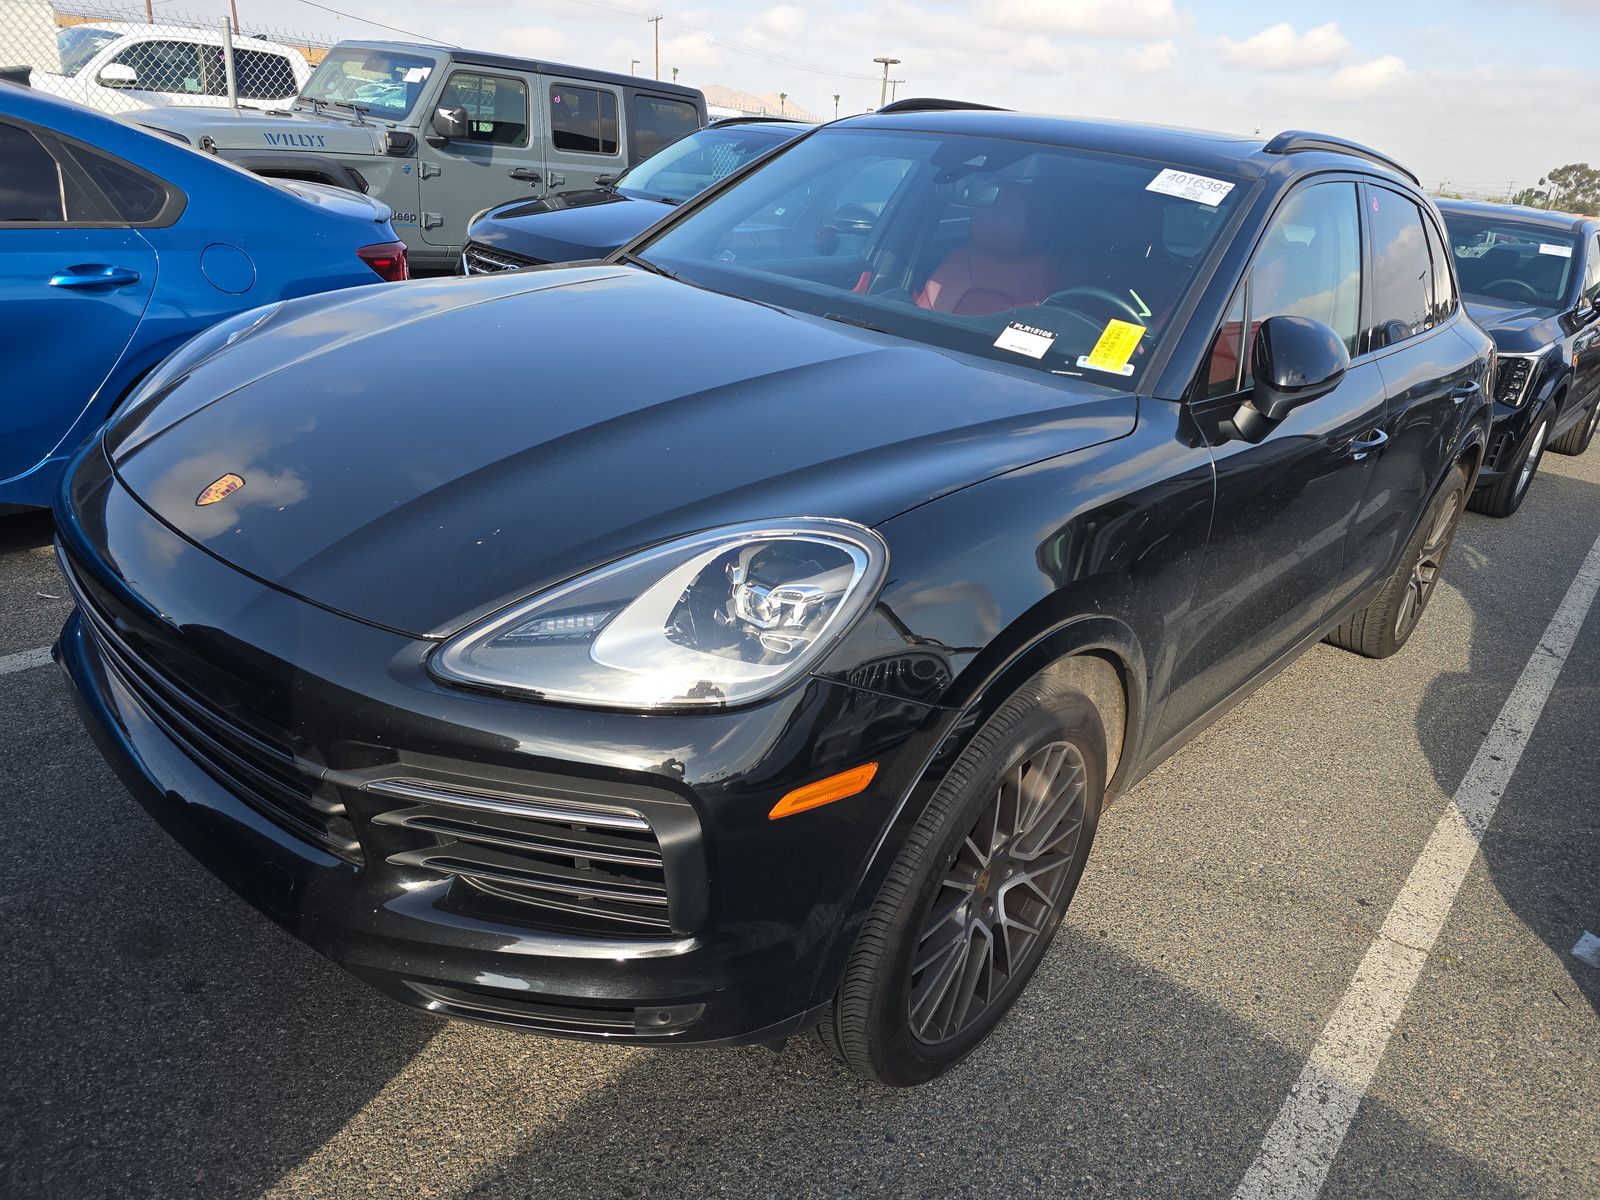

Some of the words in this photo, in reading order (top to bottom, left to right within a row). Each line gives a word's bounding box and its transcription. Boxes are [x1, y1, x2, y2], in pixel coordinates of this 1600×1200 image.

[263, 133, 325, 147] WILLYS
[1167, 173, 1233, 194] 4016395
[392, 210, 417, 223] Jeep
